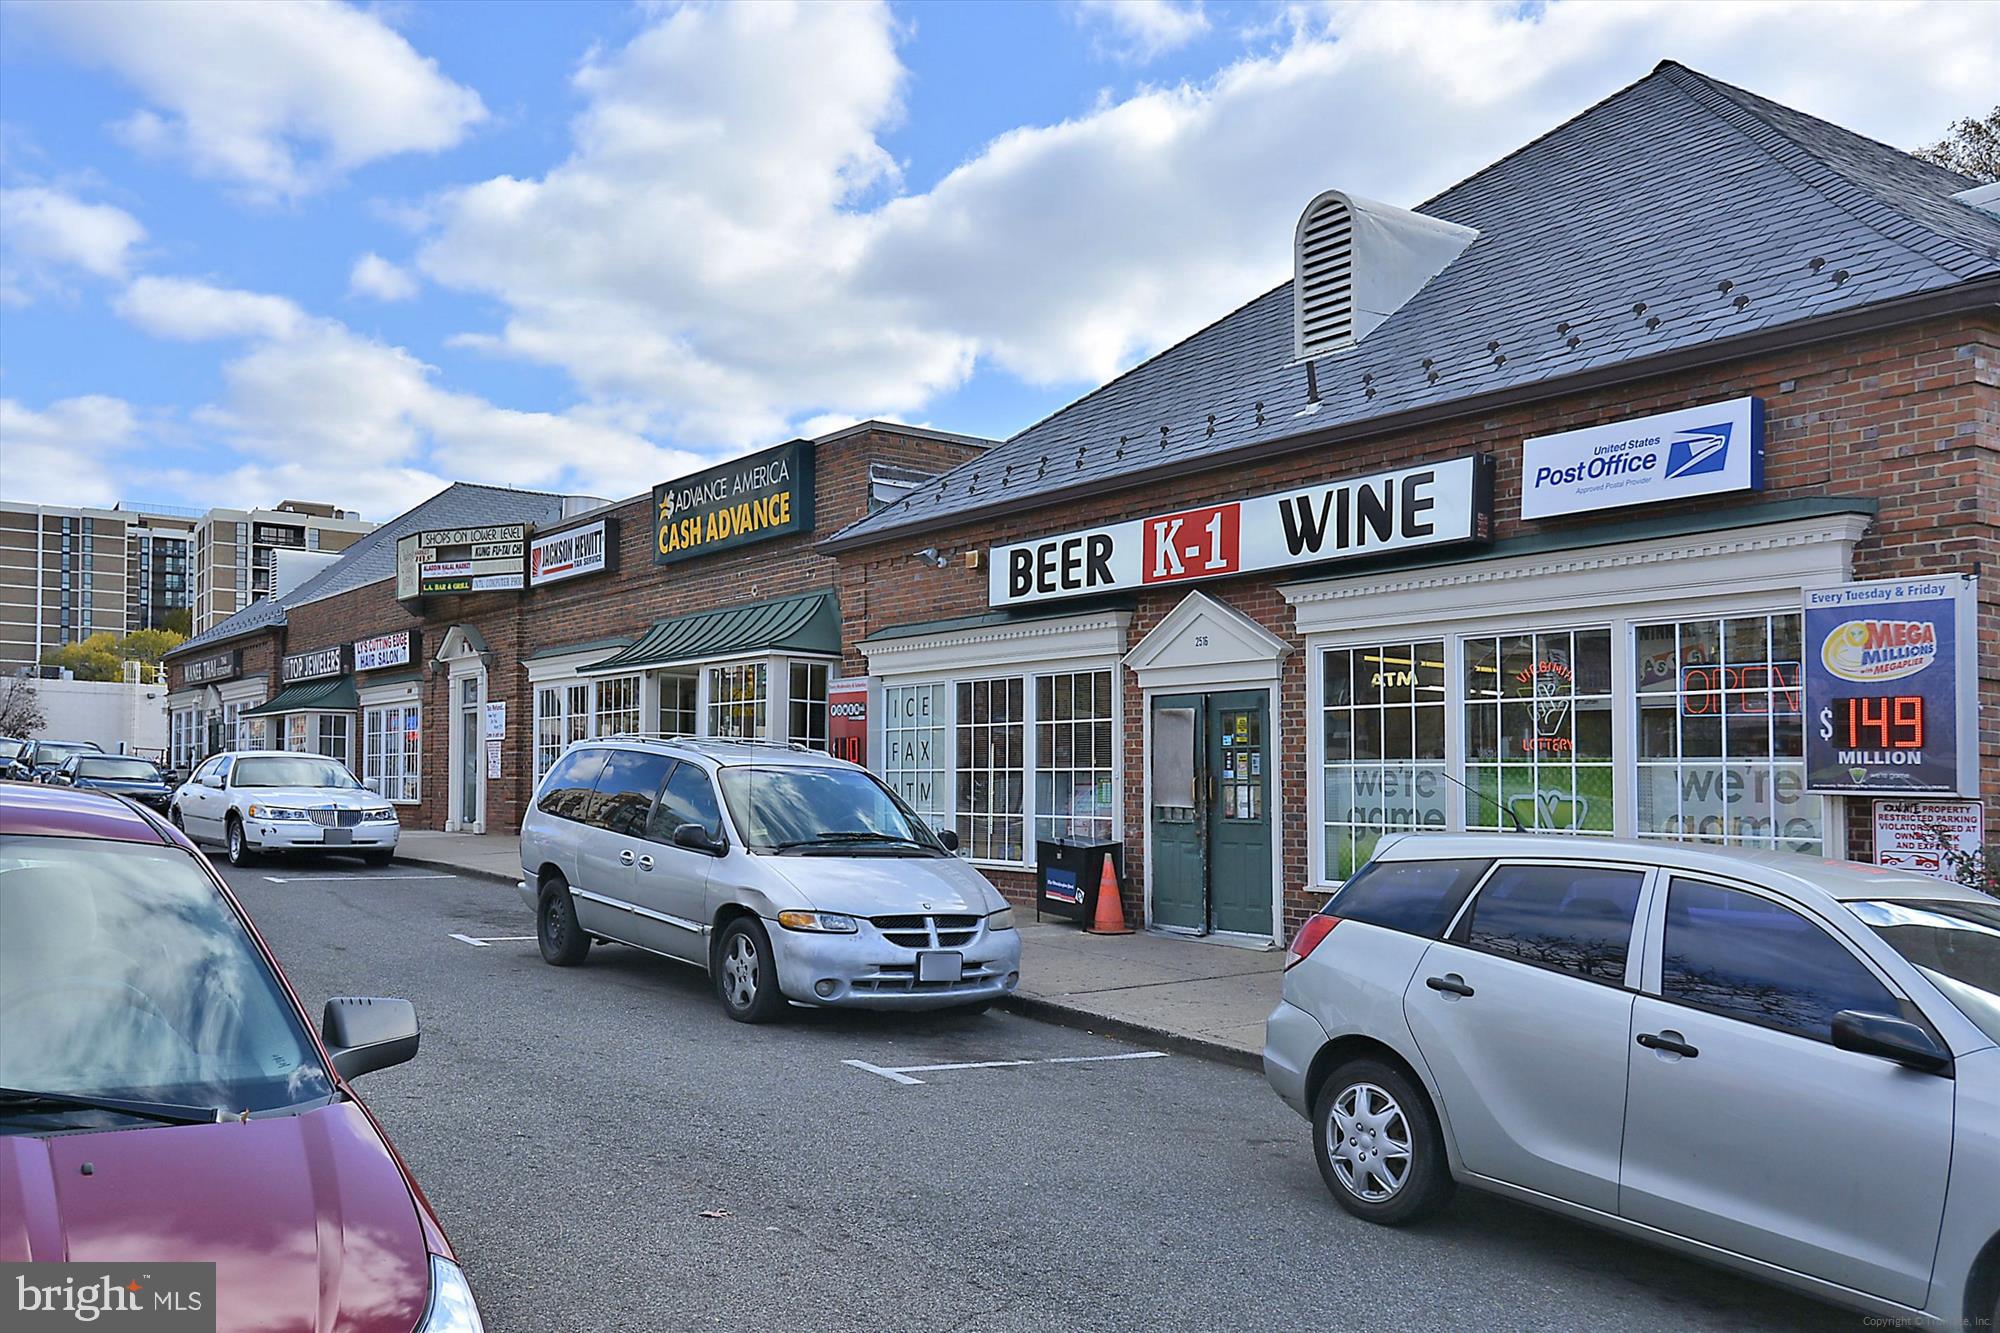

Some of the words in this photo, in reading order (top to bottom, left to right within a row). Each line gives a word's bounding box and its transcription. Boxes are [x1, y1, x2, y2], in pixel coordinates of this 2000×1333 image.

[1594, 443, 1627, 456] United
[1628, 436, 1660, 451] States
[1535, 462, 1585, 488] Post
[1587, 453, 1657, 479] Office
[675, 478, 727, 513] ADVANCE
[732, 459, 790, 496] AMERICA
[1575, 484, 1604, 495] Approved
[1605, 480, 1624, 492] Postal
[1626, 477, 1652, 488] Provider
[658, 516, 701, 554] CASH
[706, 492, 790, 543] ADVANCE
[426, 532, 451, 545] SHOPS
[454, 531, 467, 542] ON
[471, 529, 497, 542] LOWER
[501, 527, 521, 539] LEVEL
[1009, 534, 1115, 598] BEER
[1152, 512, 1227, 577] K-1
[1279, 471, 1434, 556] WINE
[475, 545, 490, 557] KUNG
[492, 544, 509, 555] FU-TAI
[512, 544, 522, 555] CHI
[542, 538, 573, 567] JACKSON
[574, 529, 602, 559] HEWITT
[573, 559, 582, 568] TAX
[583, 554, 602, 565] SERVICE
[1811, 593, 1842, 605] Every
[1846, 590, 1891, 601] Tuesday
[1895, 587, 1903, 597] &
[1908, 584, 1945, 596] Friday
[369, 636, 392, 652] CUTTING
[393, 633, 407, 647] EDGE
[1195, 636, 1208, 647] 2516
[1864, 622, 1934, 650] MEGA
[289, 658, 303, 678] TOP
[304, 650, 340, 676] JEWELERS
[360, 654, 375, 668] HAIR
[378, 649, 399, 666] SALON
[1862, 644, 1934, 666] MILLIONS
[1873, 657, 1924, 675] MEGAPLIER
[1371, 671, 1419, 688] ATM
[1685, 666, 1800, 714] OPEN
[894, 697, 929, 718] ICE
[1820, 707, 1833, 741] $
[1849, 697, 1922, 748] 149
[892, 741, 929, 761] FAX
[1522, 738, 1573, 752] LOTTERY
[1838, 751, 1921, 765] MILLION
[1354, 767, 1437, 799] we're
[1674, 765, 1802, 804] we're
[1878, 814, 1933, 822] RESTRICTED
[1937, 815, 1977, 823] PARKING
[1922, 805, 1971, 814] PROPERTY
